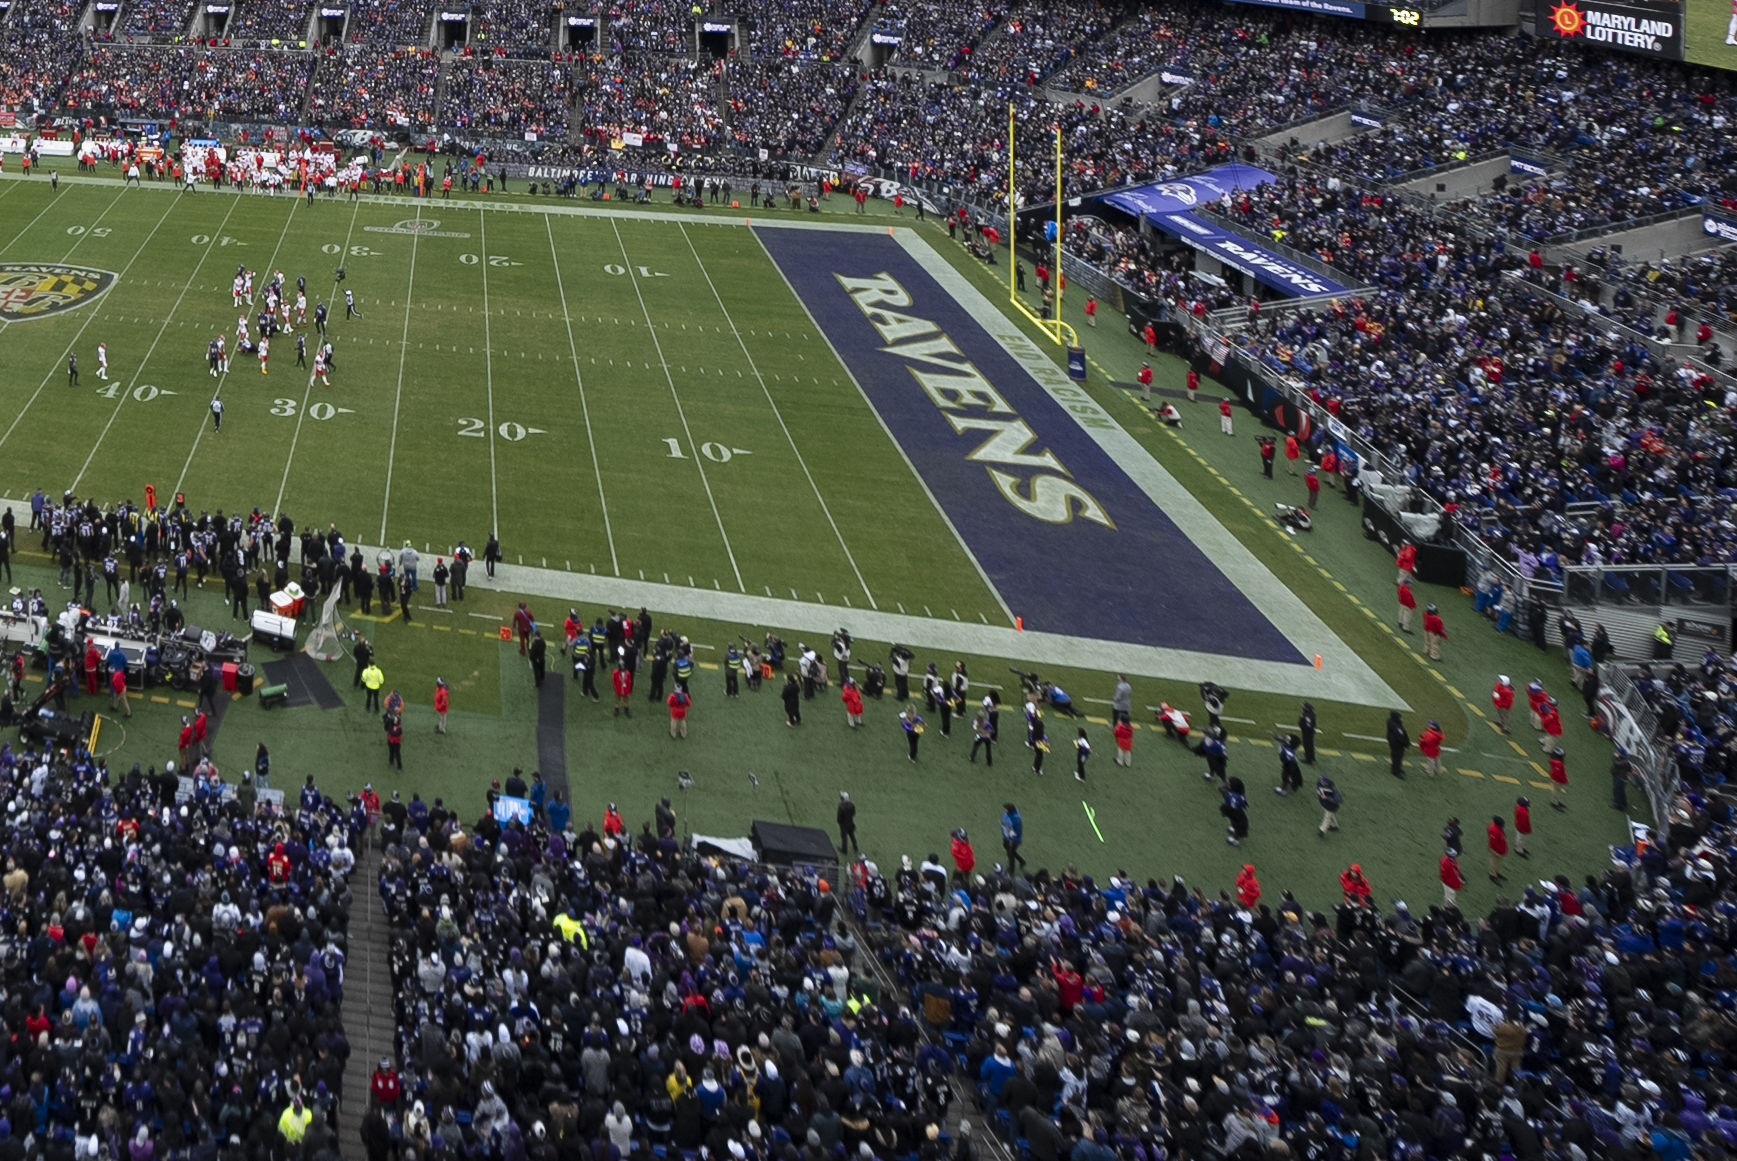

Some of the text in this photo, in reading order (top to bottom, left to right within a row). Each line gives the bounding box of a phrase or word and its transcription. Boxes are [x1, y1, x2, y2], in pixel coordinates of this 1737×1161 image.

[1301, 0, 1310, 7] of
[1310, 0, 1323, 9] the
[1323, 2, 1353, 14] Ravens.
[1586, 10, 1673, 38] MARYLAND
[1585, 25, 1657, 51] LOTTERY
[66, 225, 112, 237] 50
[3, 265, 101, 279] RAVENS
[1215, 240, 1330, 293] RAVENS
[95, 381, 159, 402] 40
[996, 333, 1118, 431] END RACISM
[268, 397, 336, 421] 30
[831, 270, 1119, 530] RAVENS
[456, 417, 527, 442] 20
[661, 437, 734, 463] 10
